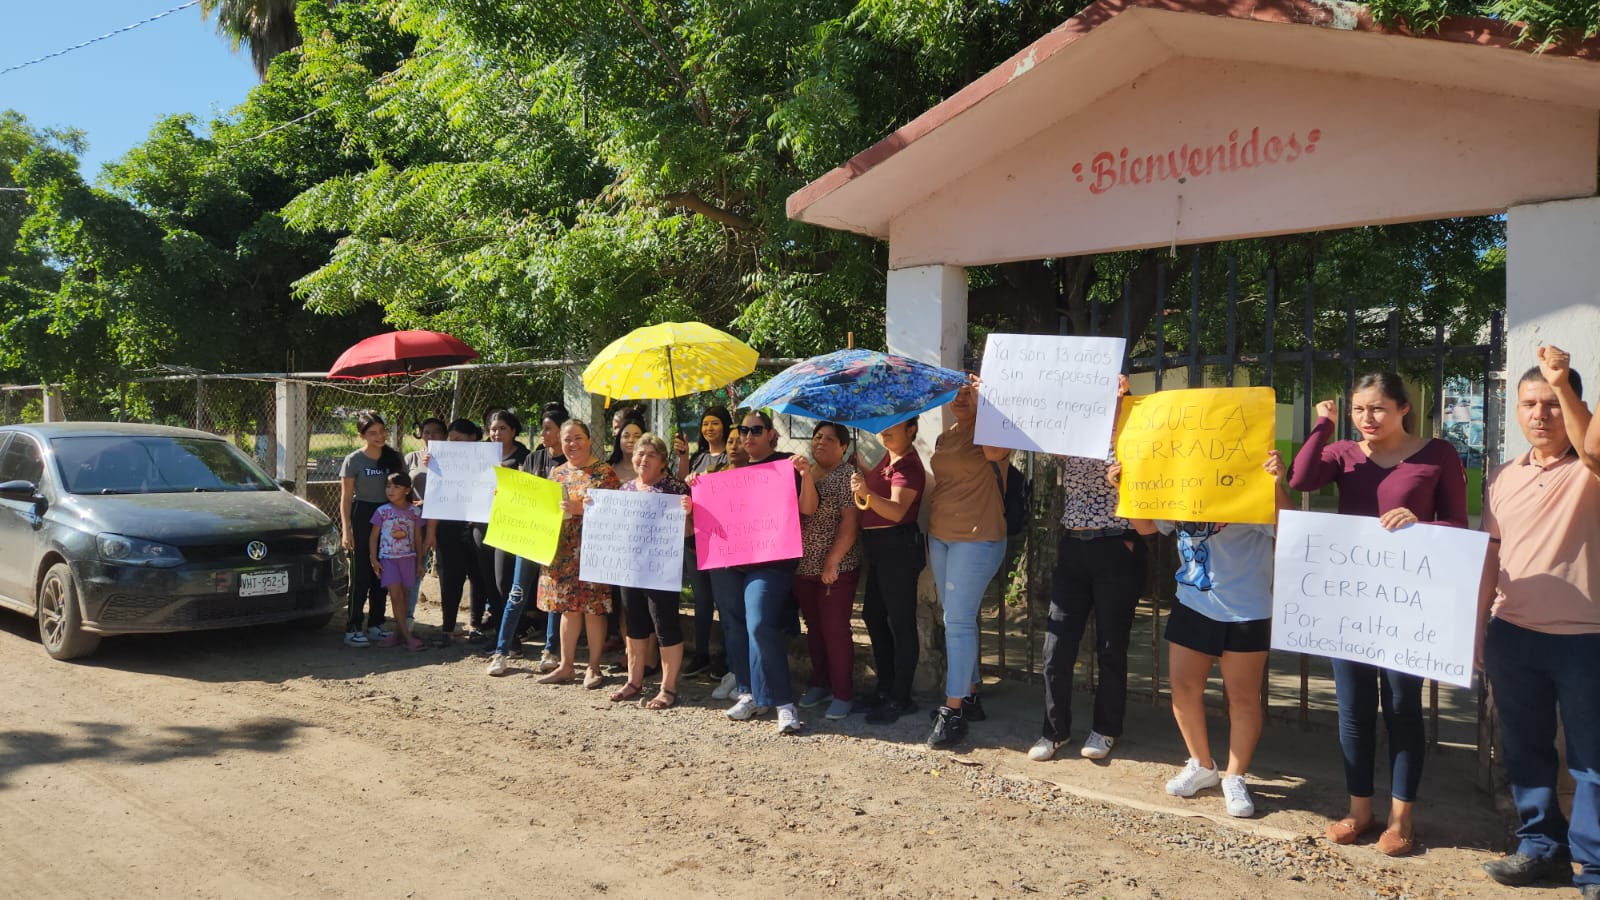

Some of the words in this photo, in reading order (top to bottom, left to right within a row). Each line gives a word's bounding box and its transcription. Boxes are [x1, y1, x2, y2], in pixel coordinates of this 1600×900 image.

[993, 340, 1009, 361] Ya
[1019, 349, 1046, 361] son
[1056, 347, 1069, 362] 13
[1074, 349, 1112, 366] años
[1001, 368, 1023, 381] sin
[1039, 369, 1110, 388] respuesta
[1125, 402, 1249, 431] ESCUELA
[1123, 437, 1250, 463] CERRADA
[1181, 476, 1206, 493] por
[1216, 468, 1246, 487] los
[623, 509, 657, 520] cerrada
[636, 524, 679, 539] respuesta
[585, 554, 599, 569] NO
[1304, 533, 1432, 579] ESCUELA
[1301, 572, 1423, 610] CERRADA
[1283, 602, 1321, 628] Por
[1338, 615, 1399, 639] falta
[1414, 622, 1437, 644] de
